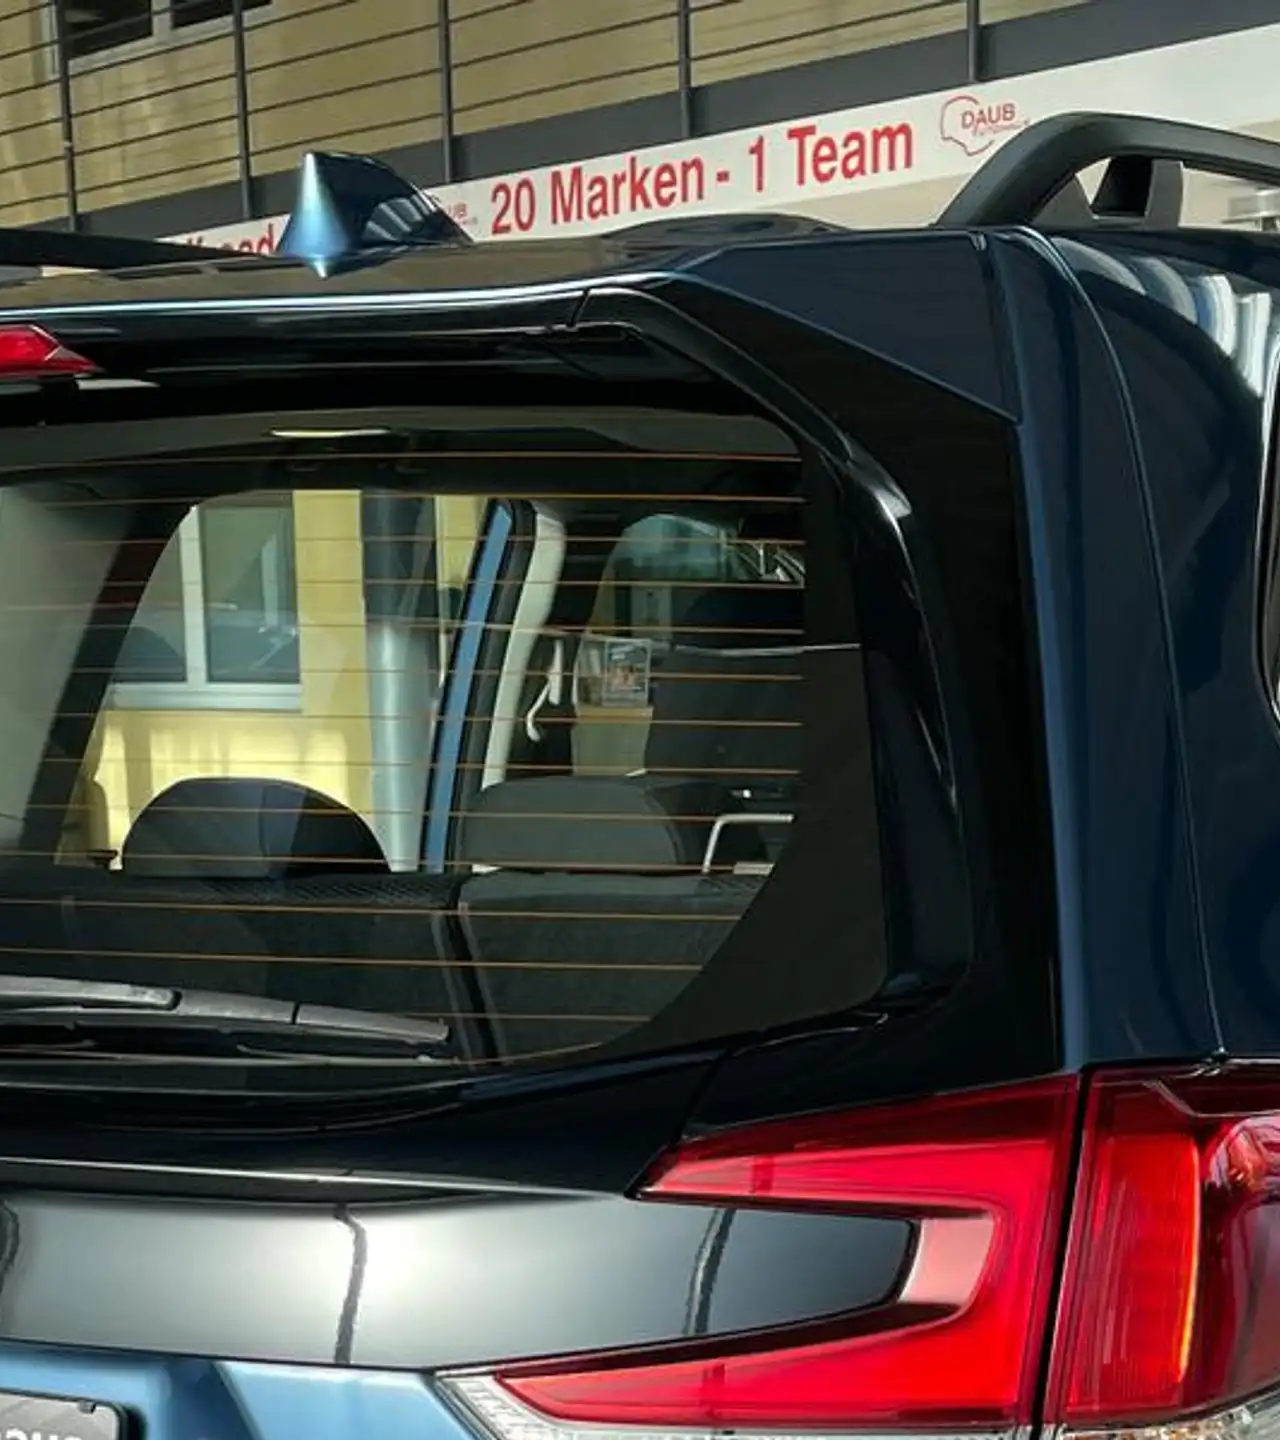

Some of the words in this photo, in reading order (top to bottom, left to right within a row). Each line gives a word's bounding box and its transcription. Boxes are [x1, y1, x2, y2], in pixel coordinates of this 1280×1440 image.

[961, 103, 1015, 131] DAUB
[491, 177, 536, 235] 20
[549, 156, 705, 224] Marken
[748, 139, 766, 193] 1
[784, 123, 913, 188] Team
